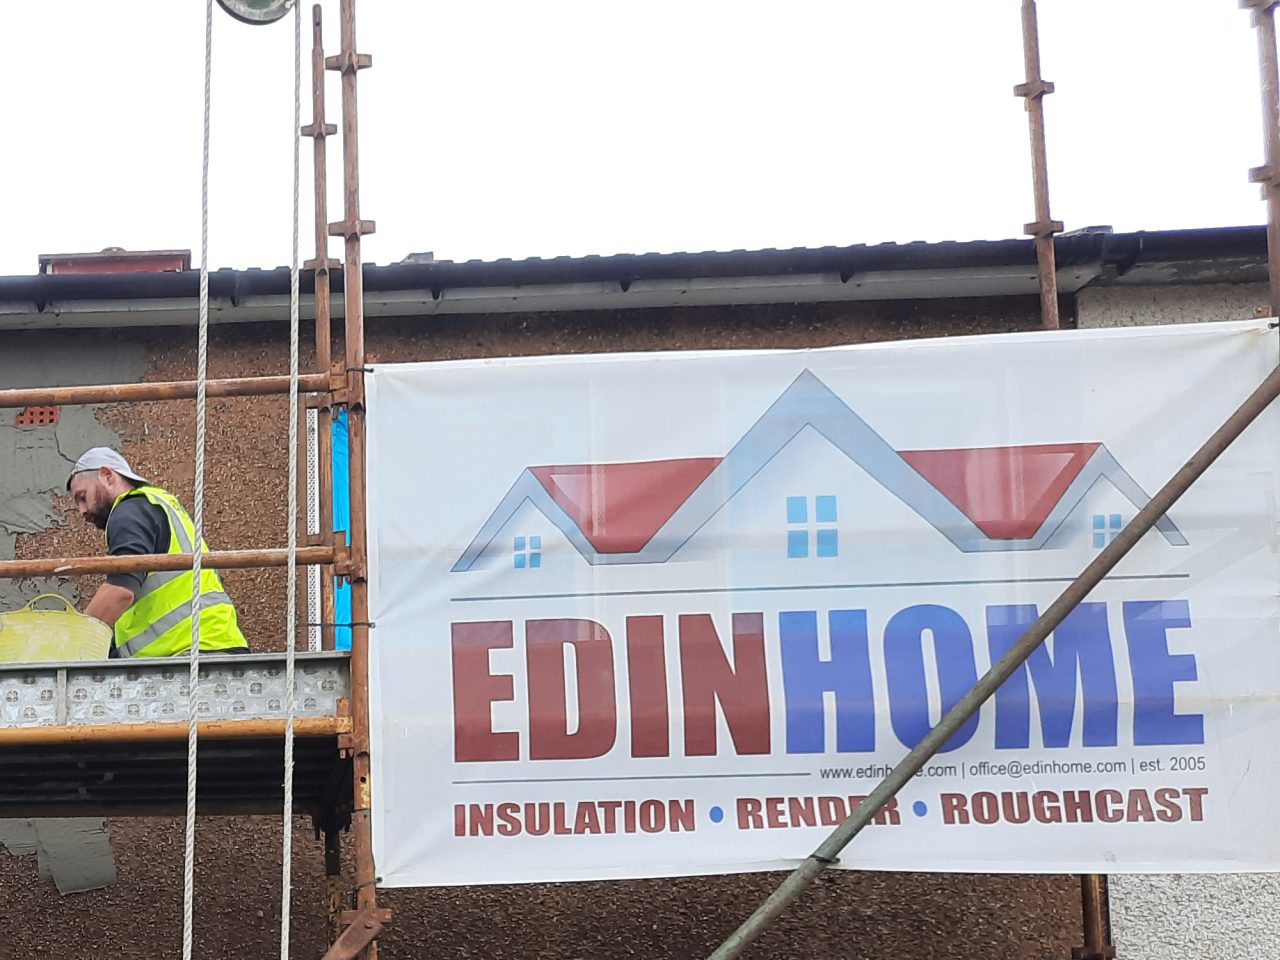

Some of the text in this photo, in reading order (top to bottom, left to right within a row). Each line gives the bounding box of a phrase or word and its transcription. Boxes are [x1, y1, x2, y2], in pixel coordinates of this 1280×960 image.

[451, 601, 1205, 763] EDINHOME
[969, 759, 1127, 778] office@edinhome.com
[1140, 759, 1165, 771] est.
[1169, 757, 1206, 771] 2005
[454, 800, 696, 837] INSULATION
[940, 788, 1208, 825] ROUGHCAST
